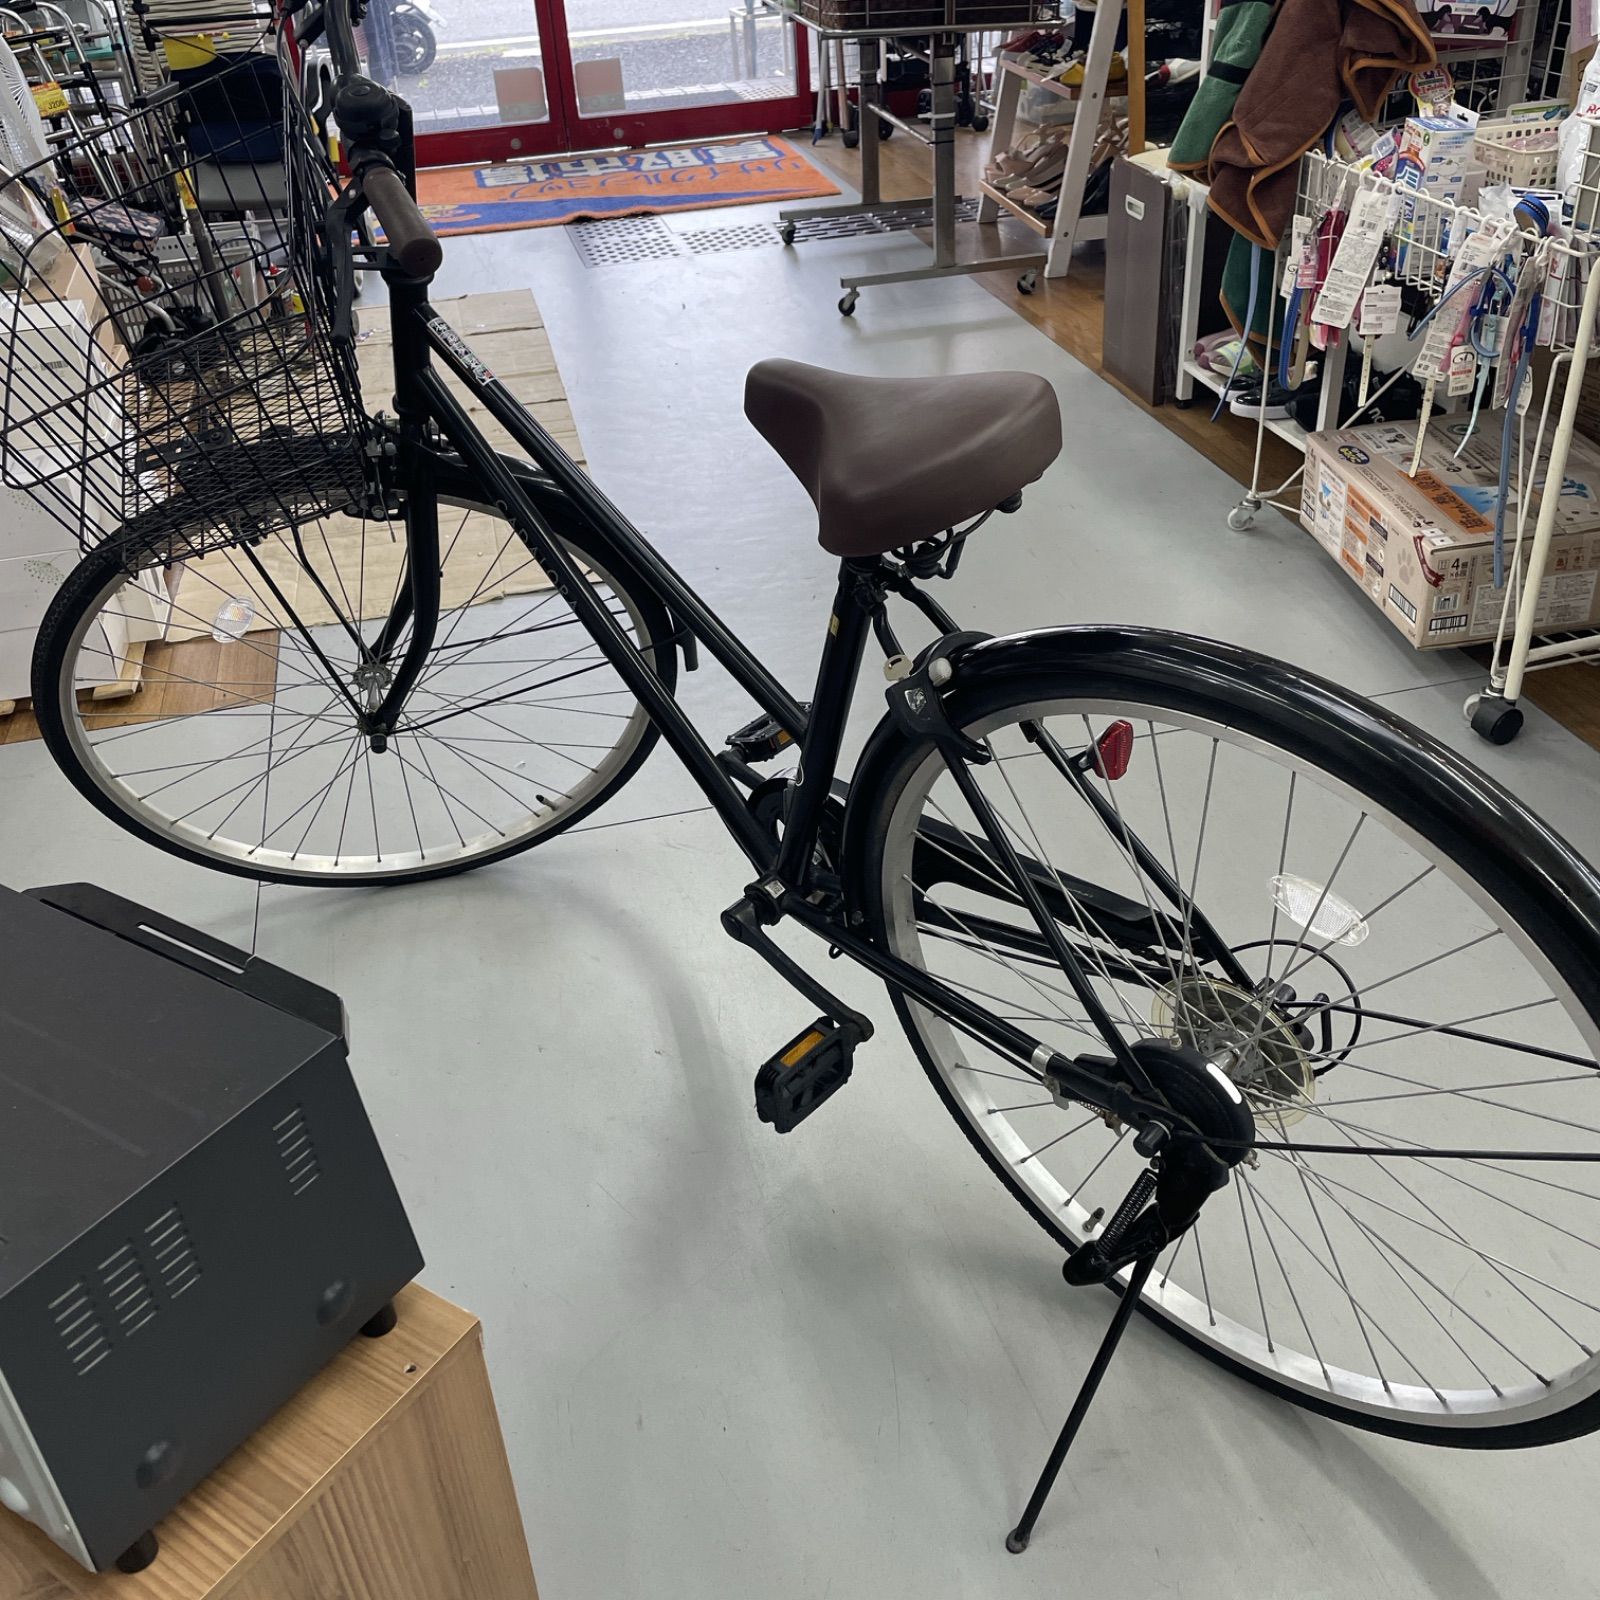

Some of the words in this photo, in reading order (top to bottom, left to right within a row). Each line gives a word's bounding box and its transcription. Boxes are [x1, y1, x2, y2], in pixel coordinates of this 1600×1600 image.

[476, 139, 785, 189] 買取市場
[499, 159, 801, 202] リサイクルショップ
